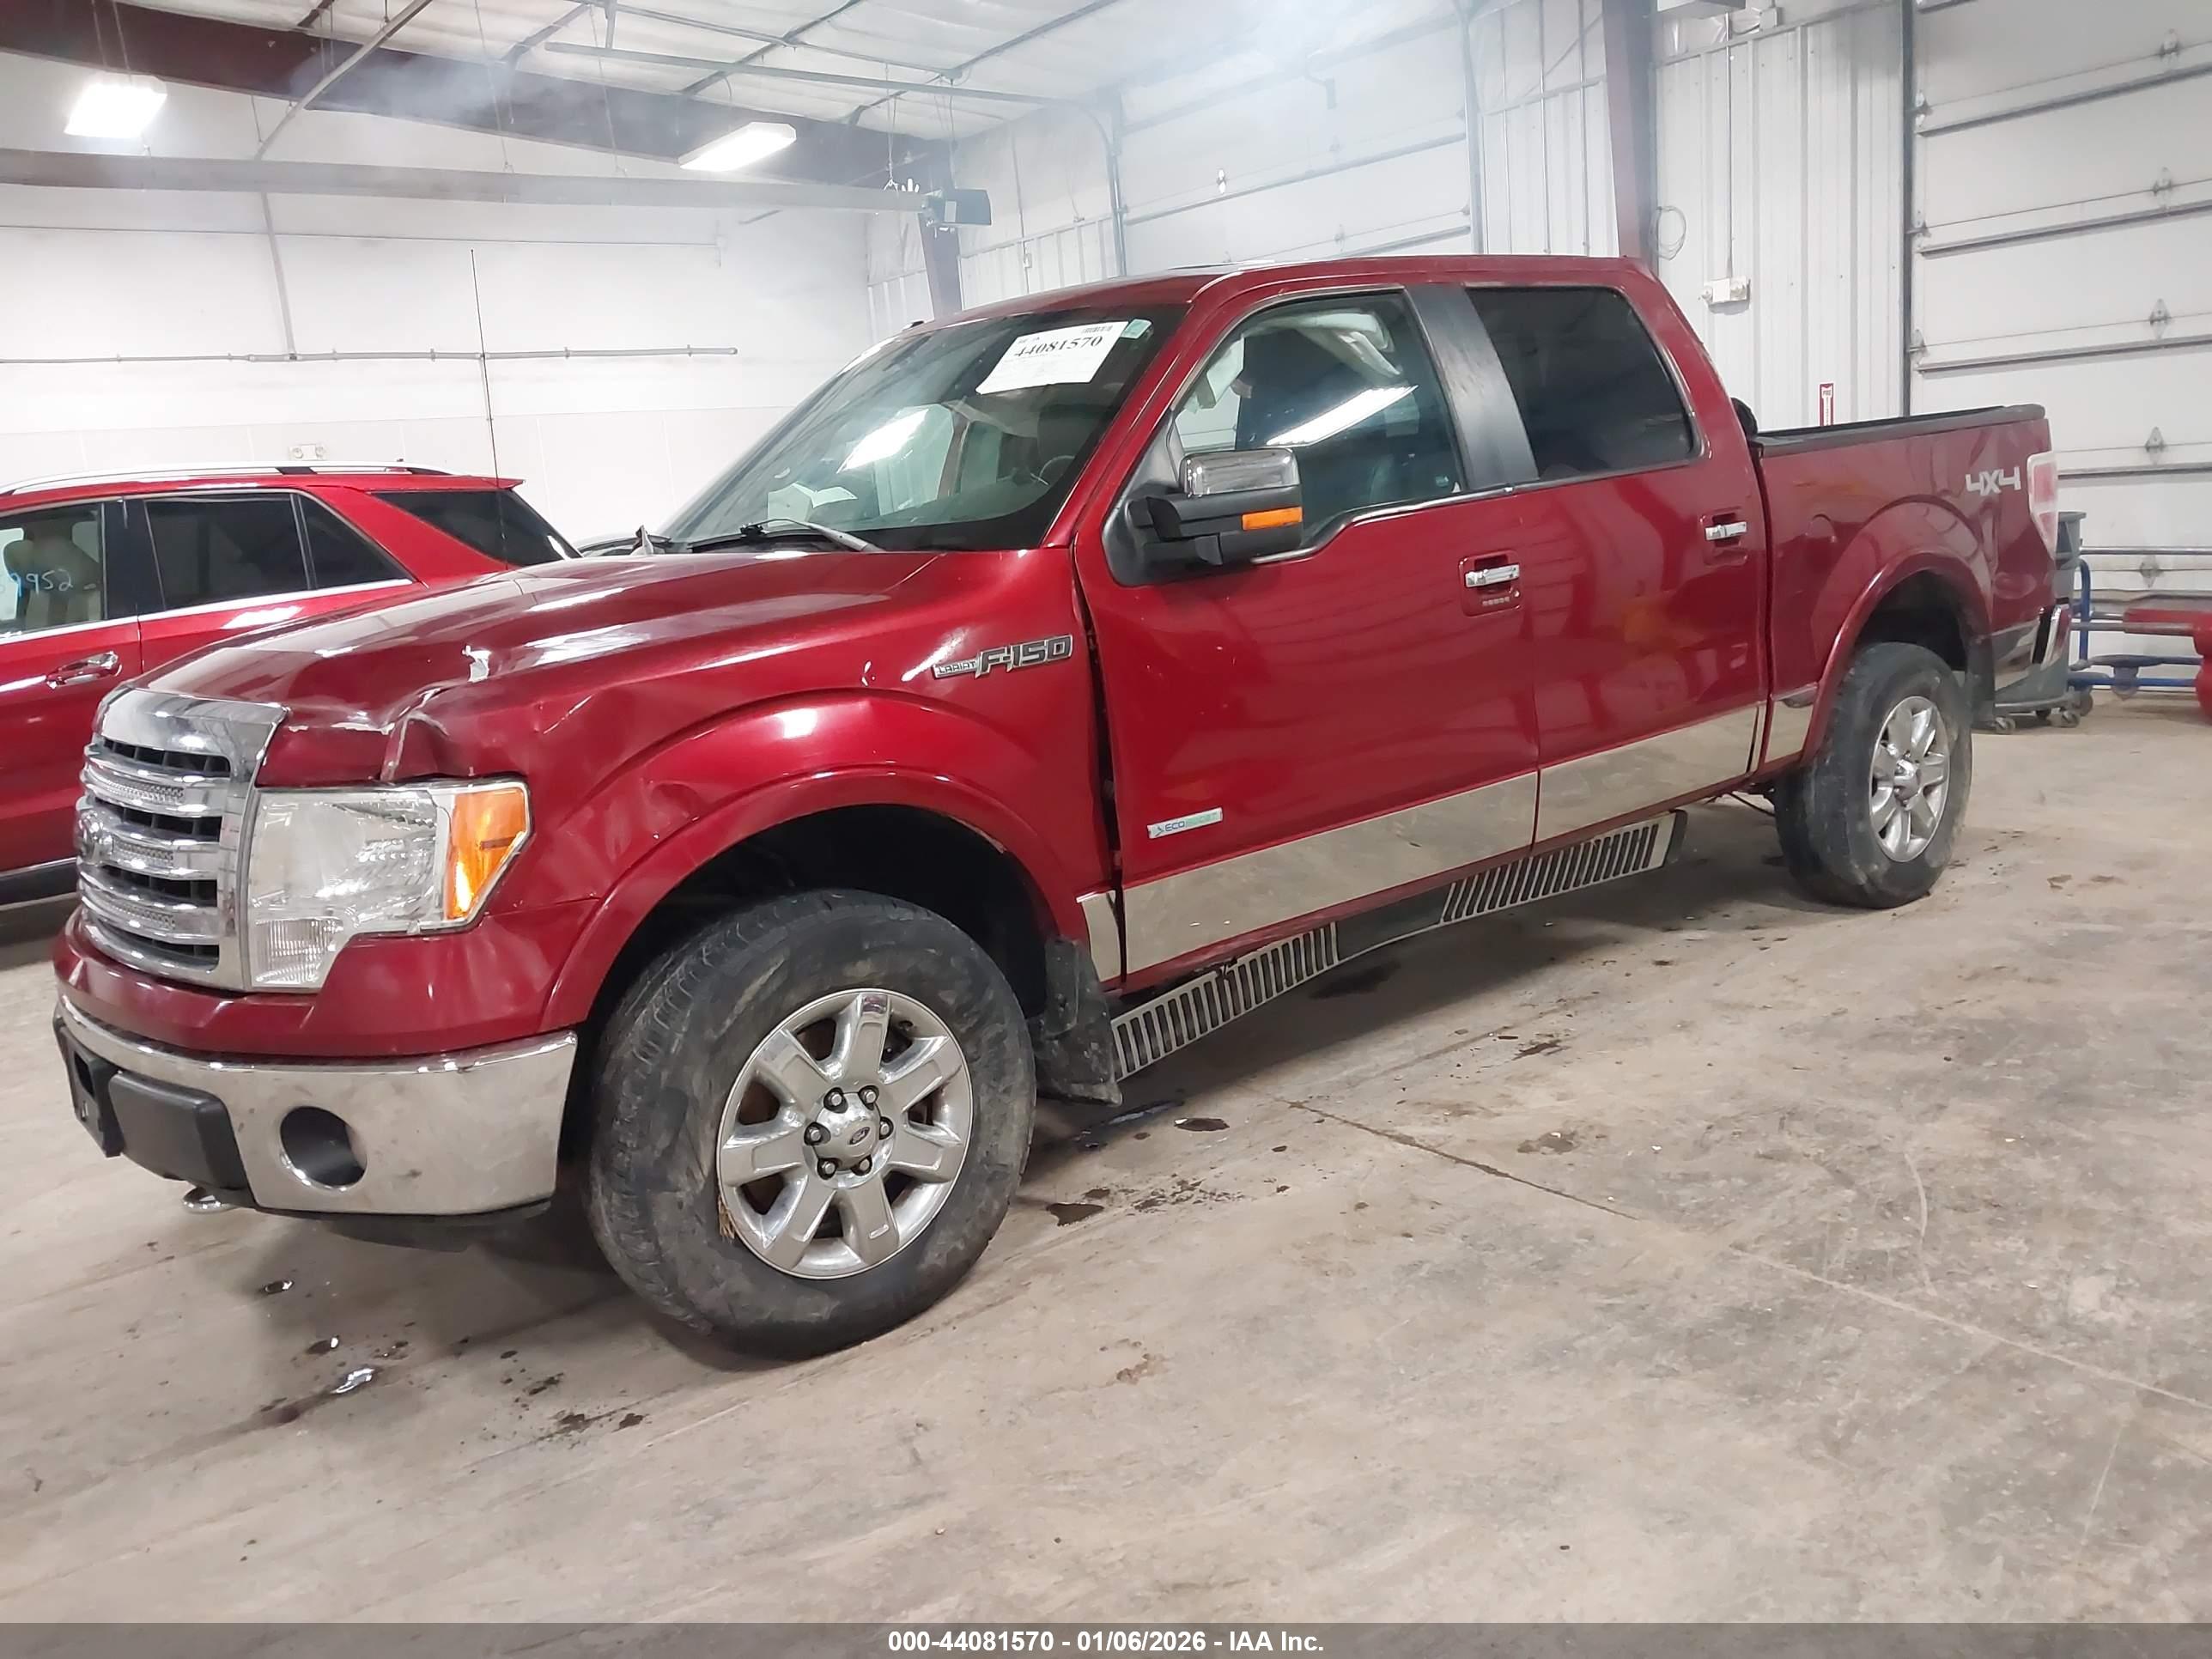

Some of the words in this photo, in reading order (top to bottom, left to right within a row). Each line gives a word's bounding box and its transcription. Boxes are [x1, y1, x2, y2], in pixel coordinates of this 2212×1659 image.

[1014, 336, 1103, 357] 44081570
[939, 660, 976, 673] LARIAT
[975, 635, 1073, 678] F-150
[1164, 820, 1185, 832] ECO
